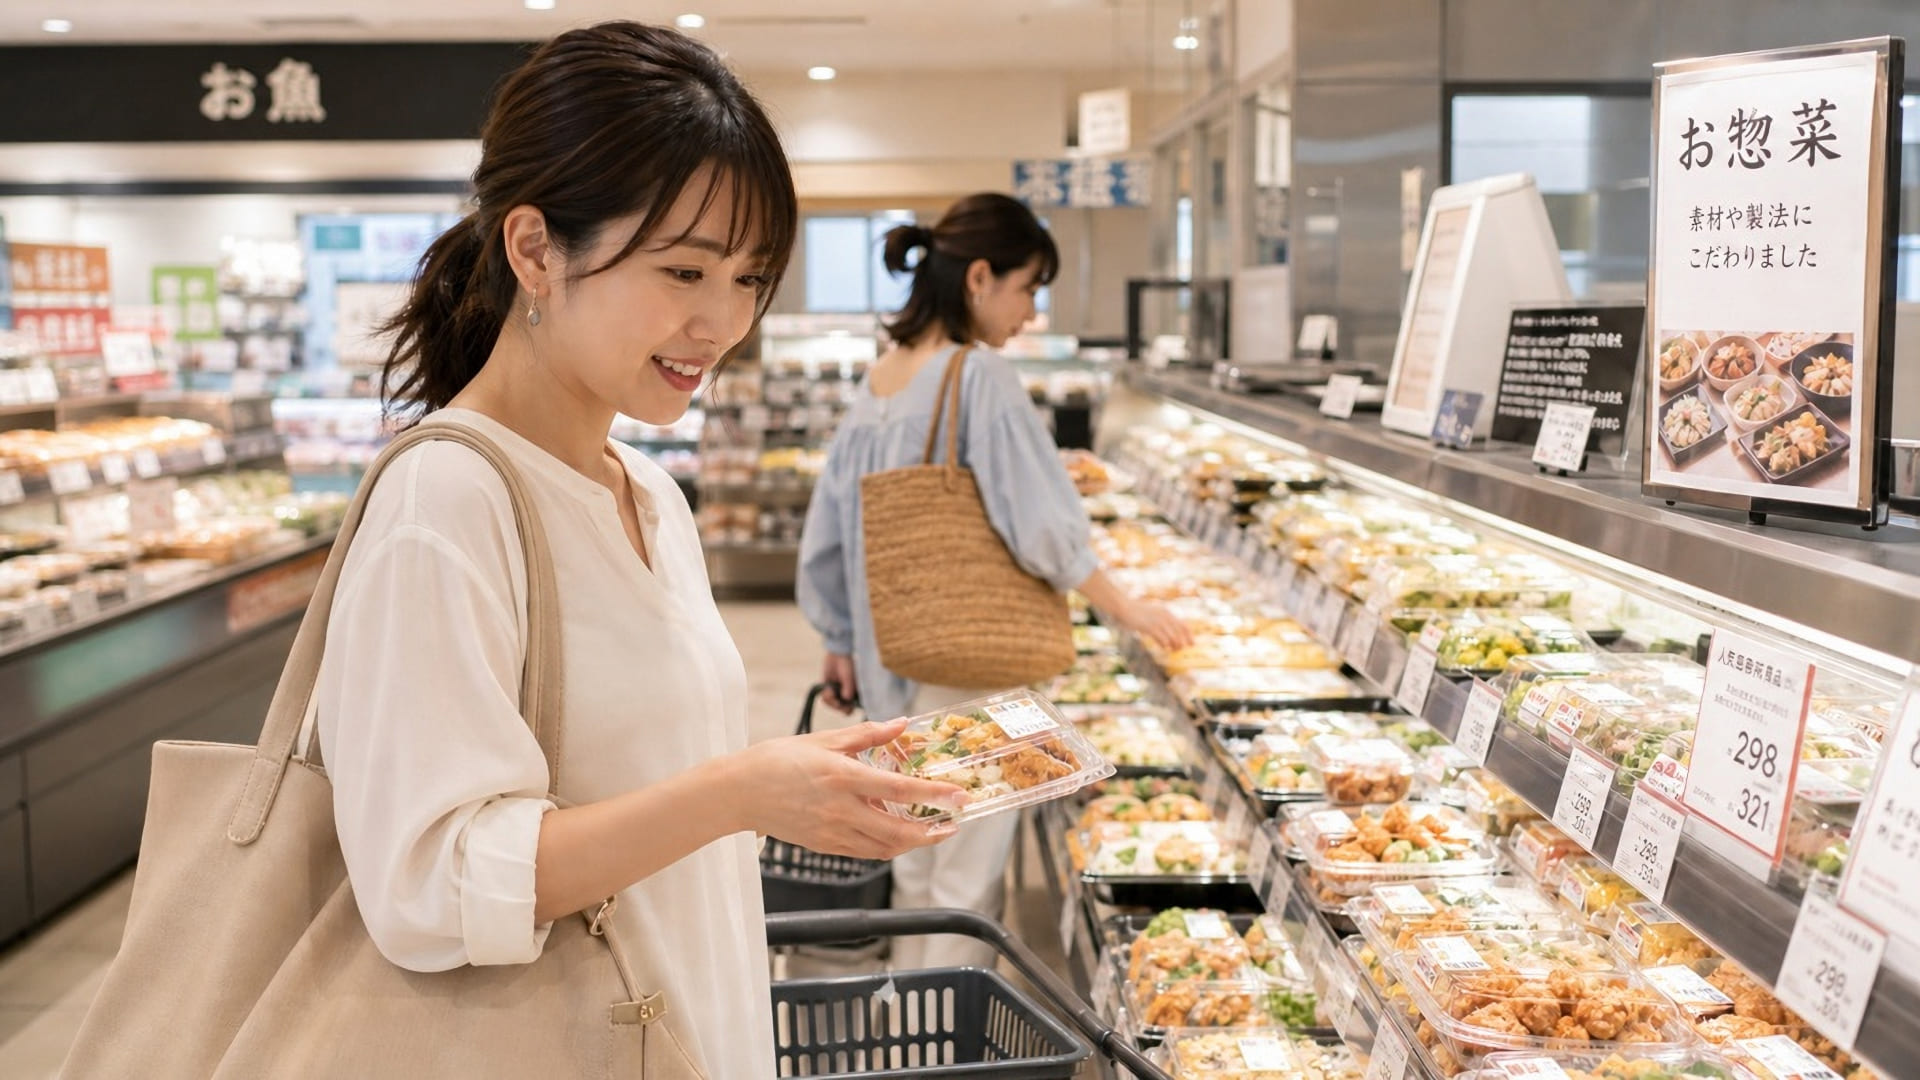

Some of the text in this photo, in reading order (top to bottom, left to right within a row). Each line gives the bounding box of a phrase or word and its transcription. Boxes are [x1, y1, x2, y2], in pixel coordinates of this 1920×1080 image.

[200, 57, 327, 122] お魚
[1679, 98, 1842, 171] お惣菜
[1688, 203, 1812, 232] 素材や製法に
[1690, 243, 1817, 269] こだわりました
[1733, 731, 1778, 778] 298
[1737, 788, 1770, 832] 321
